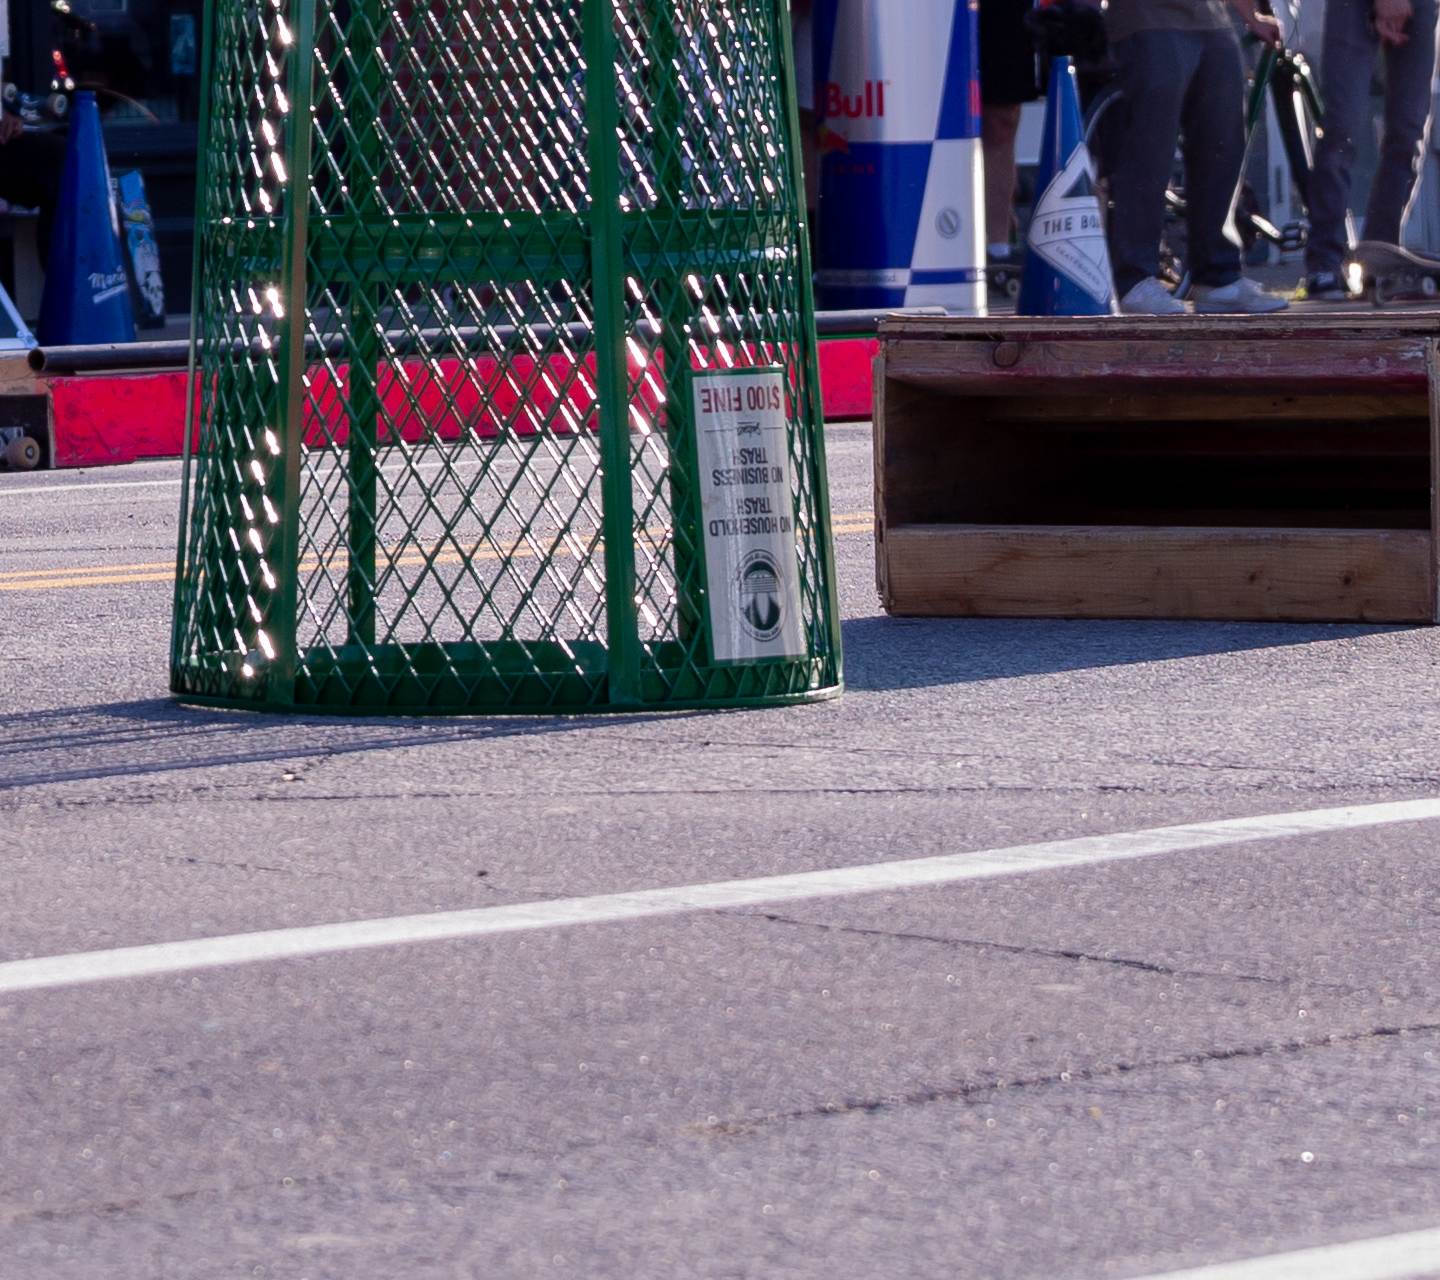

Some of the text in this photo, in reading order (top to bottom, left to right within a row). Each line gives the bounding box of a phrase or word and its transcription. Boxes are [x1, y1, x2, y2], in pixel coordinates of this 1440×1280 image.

[826, 80, 885, 118] Bull
[1042, 216, 1073, 236] THE
[701, 385, 781, 414] $100 FINE
[732, 446, 769, 466] TRASH
[711, 466, 784, 488] NO BUSINESS
[737, 496, 773, 515] TRASH
[708, 515, 792, 537] NO HOUSEHOLD
